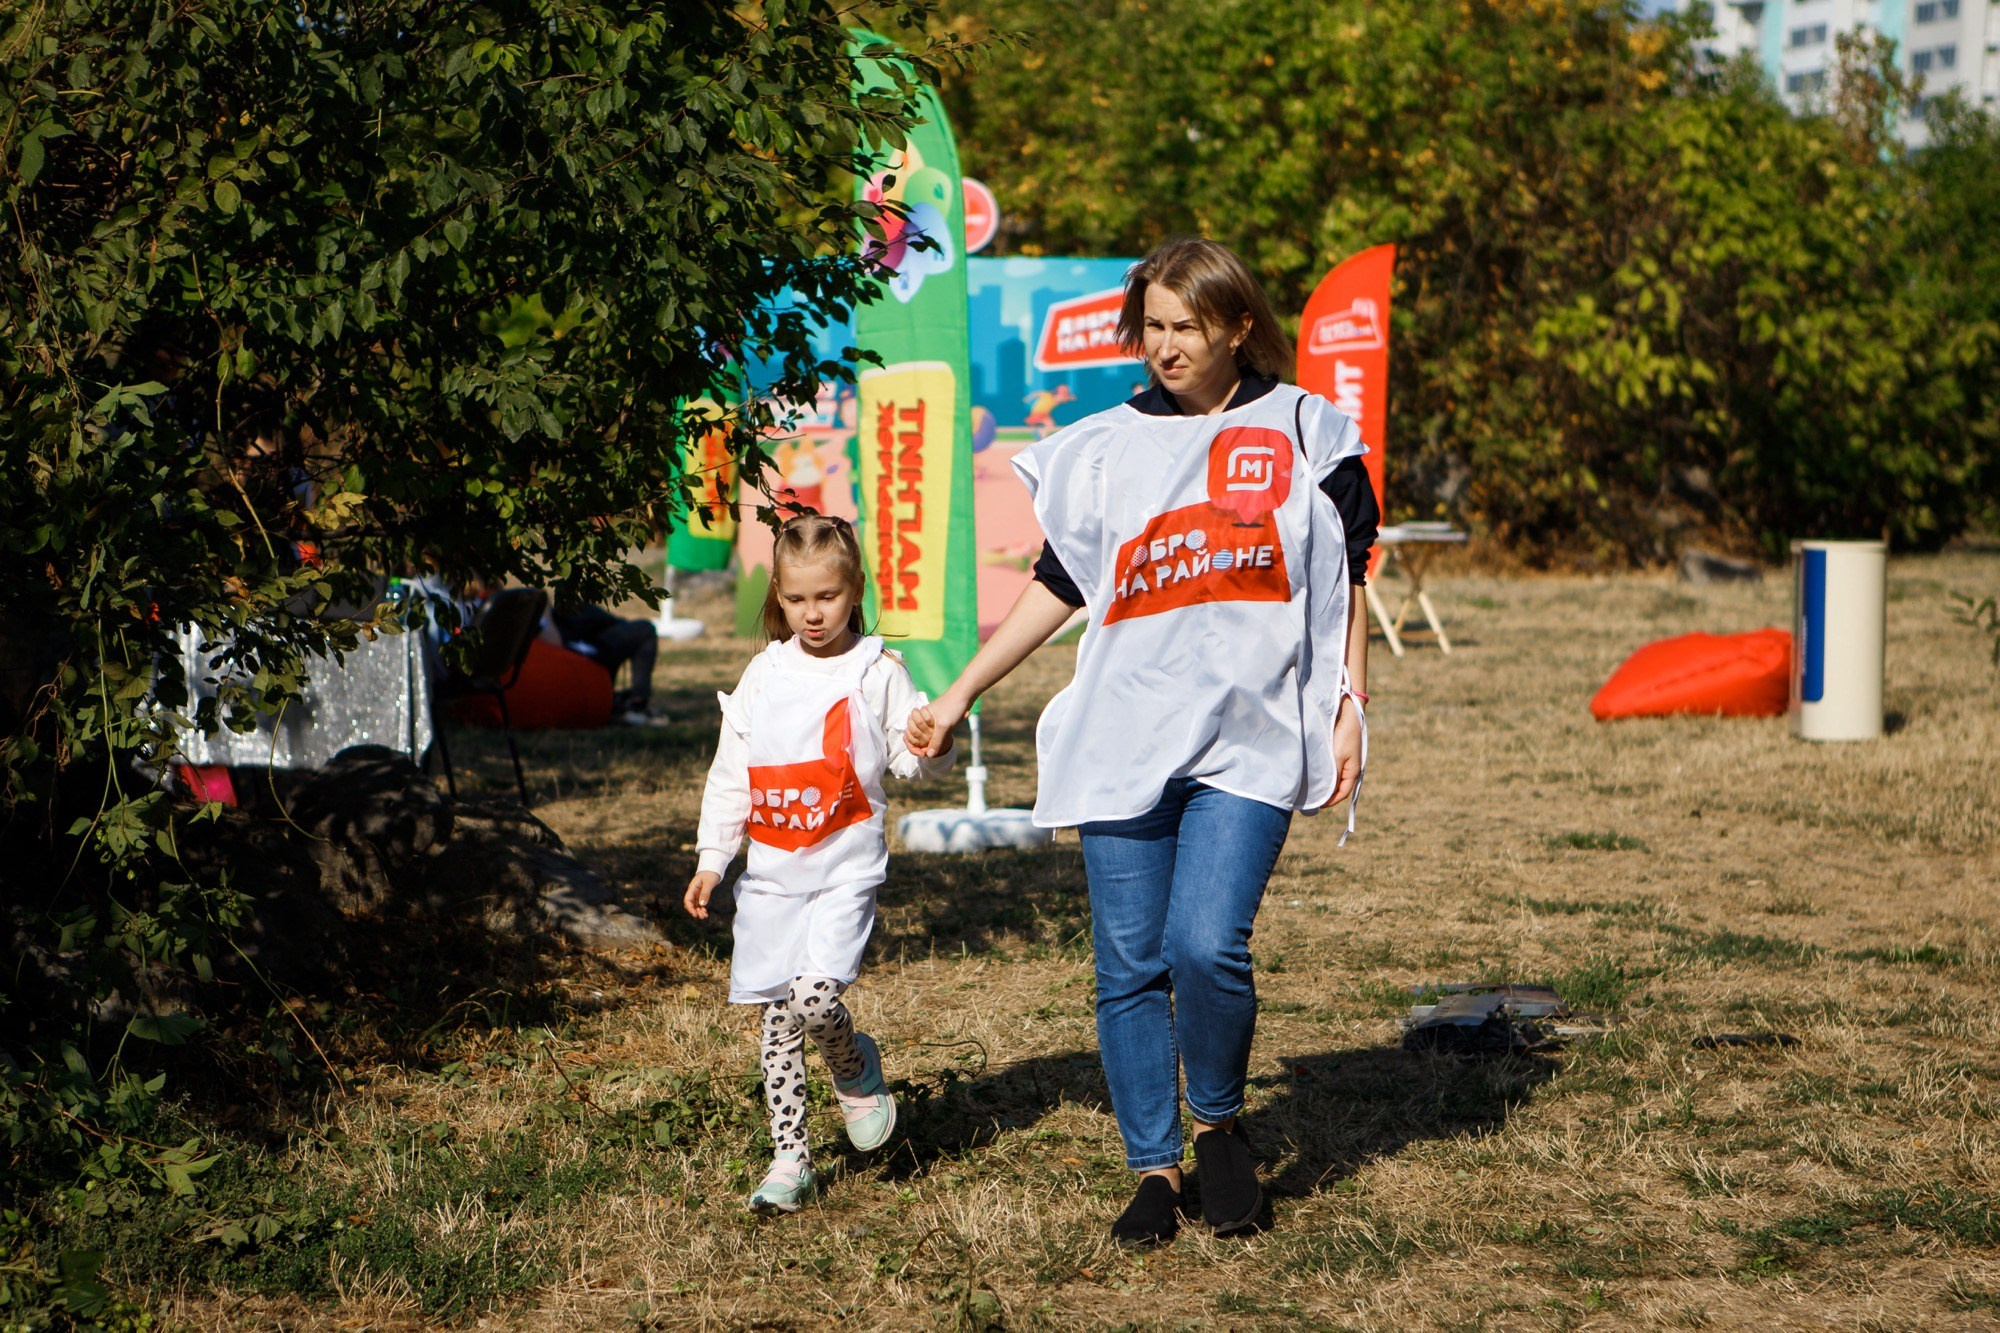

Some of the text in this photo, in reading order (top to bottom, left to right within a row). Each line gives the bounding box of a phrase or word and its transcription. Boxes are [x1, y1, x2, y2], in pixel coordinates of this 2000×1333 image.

[1125, 529, 1207, 575] ОБРО
[1156, 545, 1274, 588] РАЙОНЕ
[751, 786, 821, 808] ОБРО
